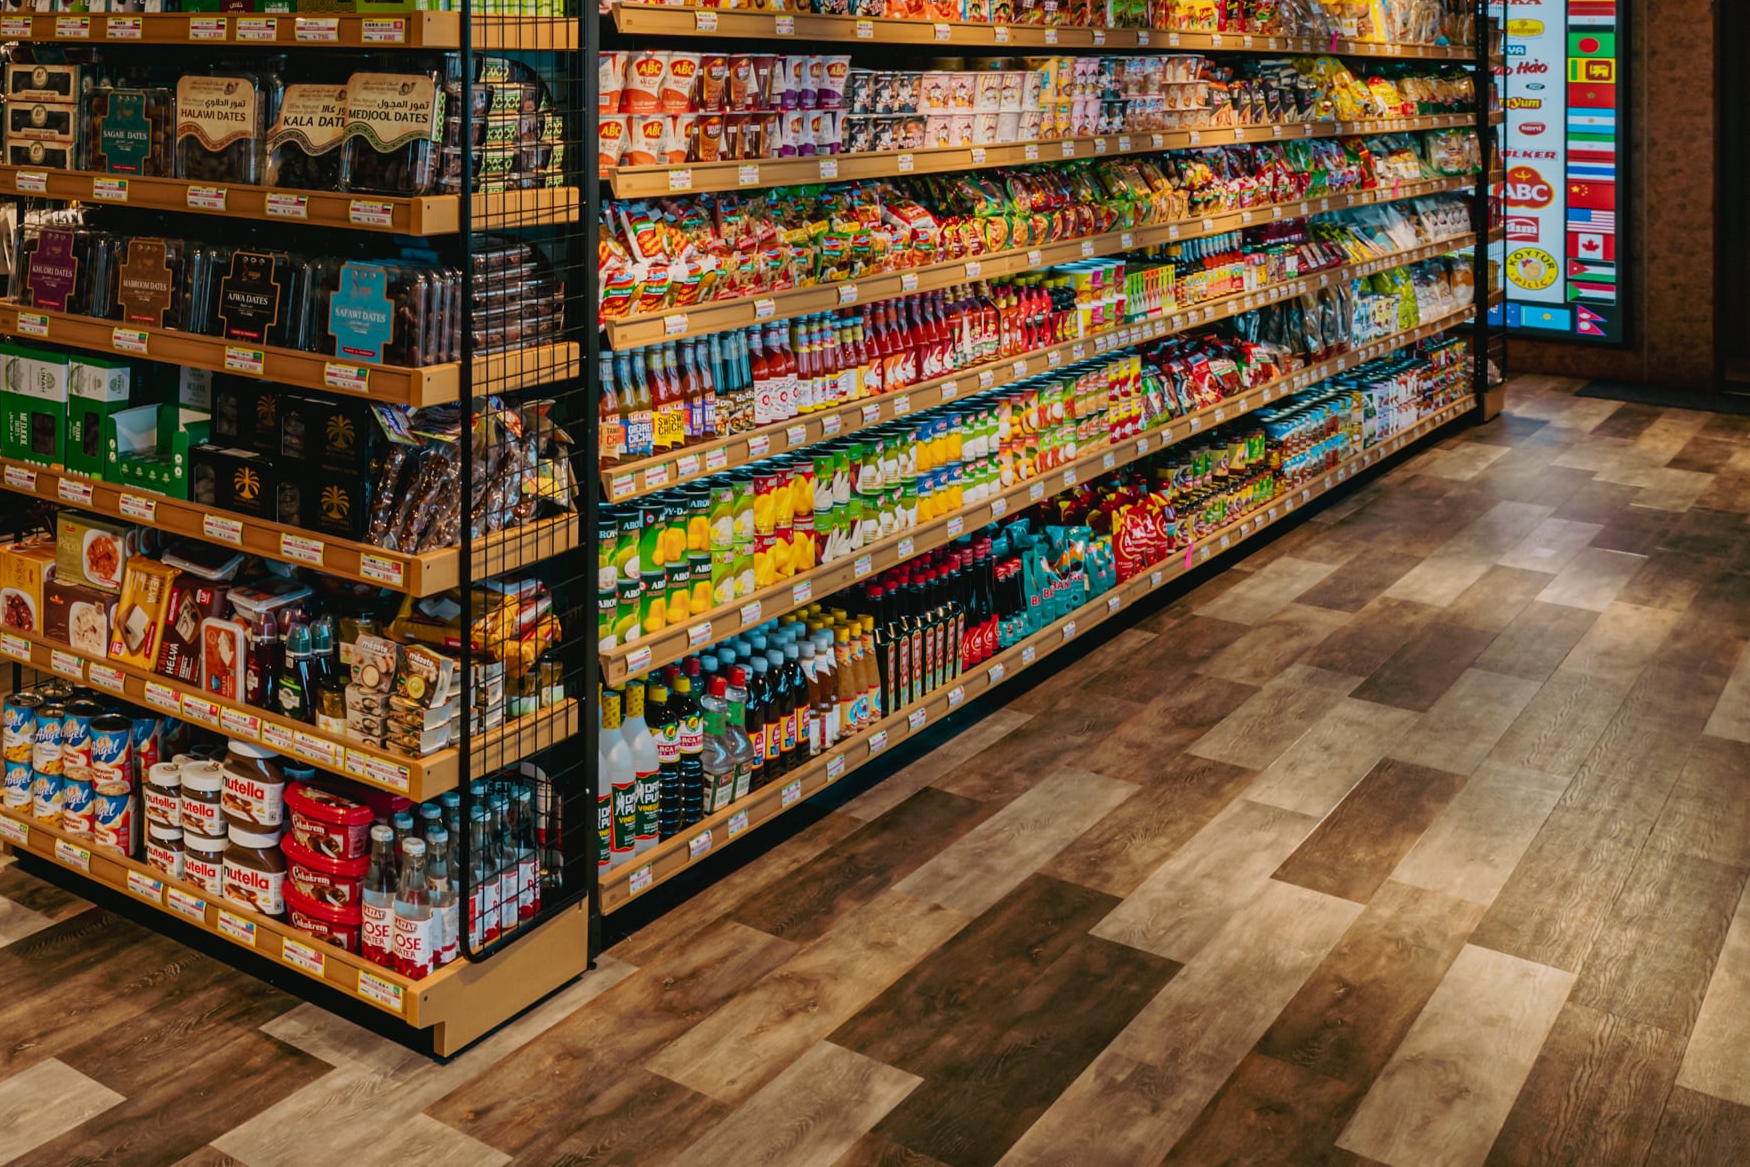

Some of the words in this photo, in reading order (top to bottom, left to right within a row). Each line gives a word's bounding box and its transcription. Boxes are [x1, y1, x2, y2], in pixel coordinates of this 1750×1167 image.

[639, 60, 661, 75] ABC
[673, 60, 696, 75] ABC
[829, 62, 847, 76] ABC
[181, 108, 215, 121] HALAWI
[217, 110, 246, 122] DATES
[283, 116, 314, 127] KALA
[318, 116, 345, 128] DAT
[349, 109, 392, 122] MEDJOOL
[394, 112, 428, 124] DATES
[128, 131, 147, 140] DATES
[601, 125, 621, 138] ABC
[1500, 184, 1549, 202] ABC
[32, 265, 53, 274] KHUDRI
[53, 267, 73, 277] DATES
[150, 282, 167, 291] DATES
[227, 293, 247, 303] AJWA
[248, 295, 268, 306] DATES
[335, 306, 361, 321] SAFAWI
[362, 310, 386, 323] DATES
[673, 572, 690, 581] ARO
[166, 643, 179, 674] HELVA
[5, 770, 34, 786] Angel
[222, 775, 265, 800] nutella
[145, 792, 176, 811] nutella
[644, 793, 659, 803] PUT
[182, 800, 214, 818] utella
[638, 804, 659, 812] VINEGA
[185, 860, 216, 878] utella
[224, 864, 269, 890] nutella
